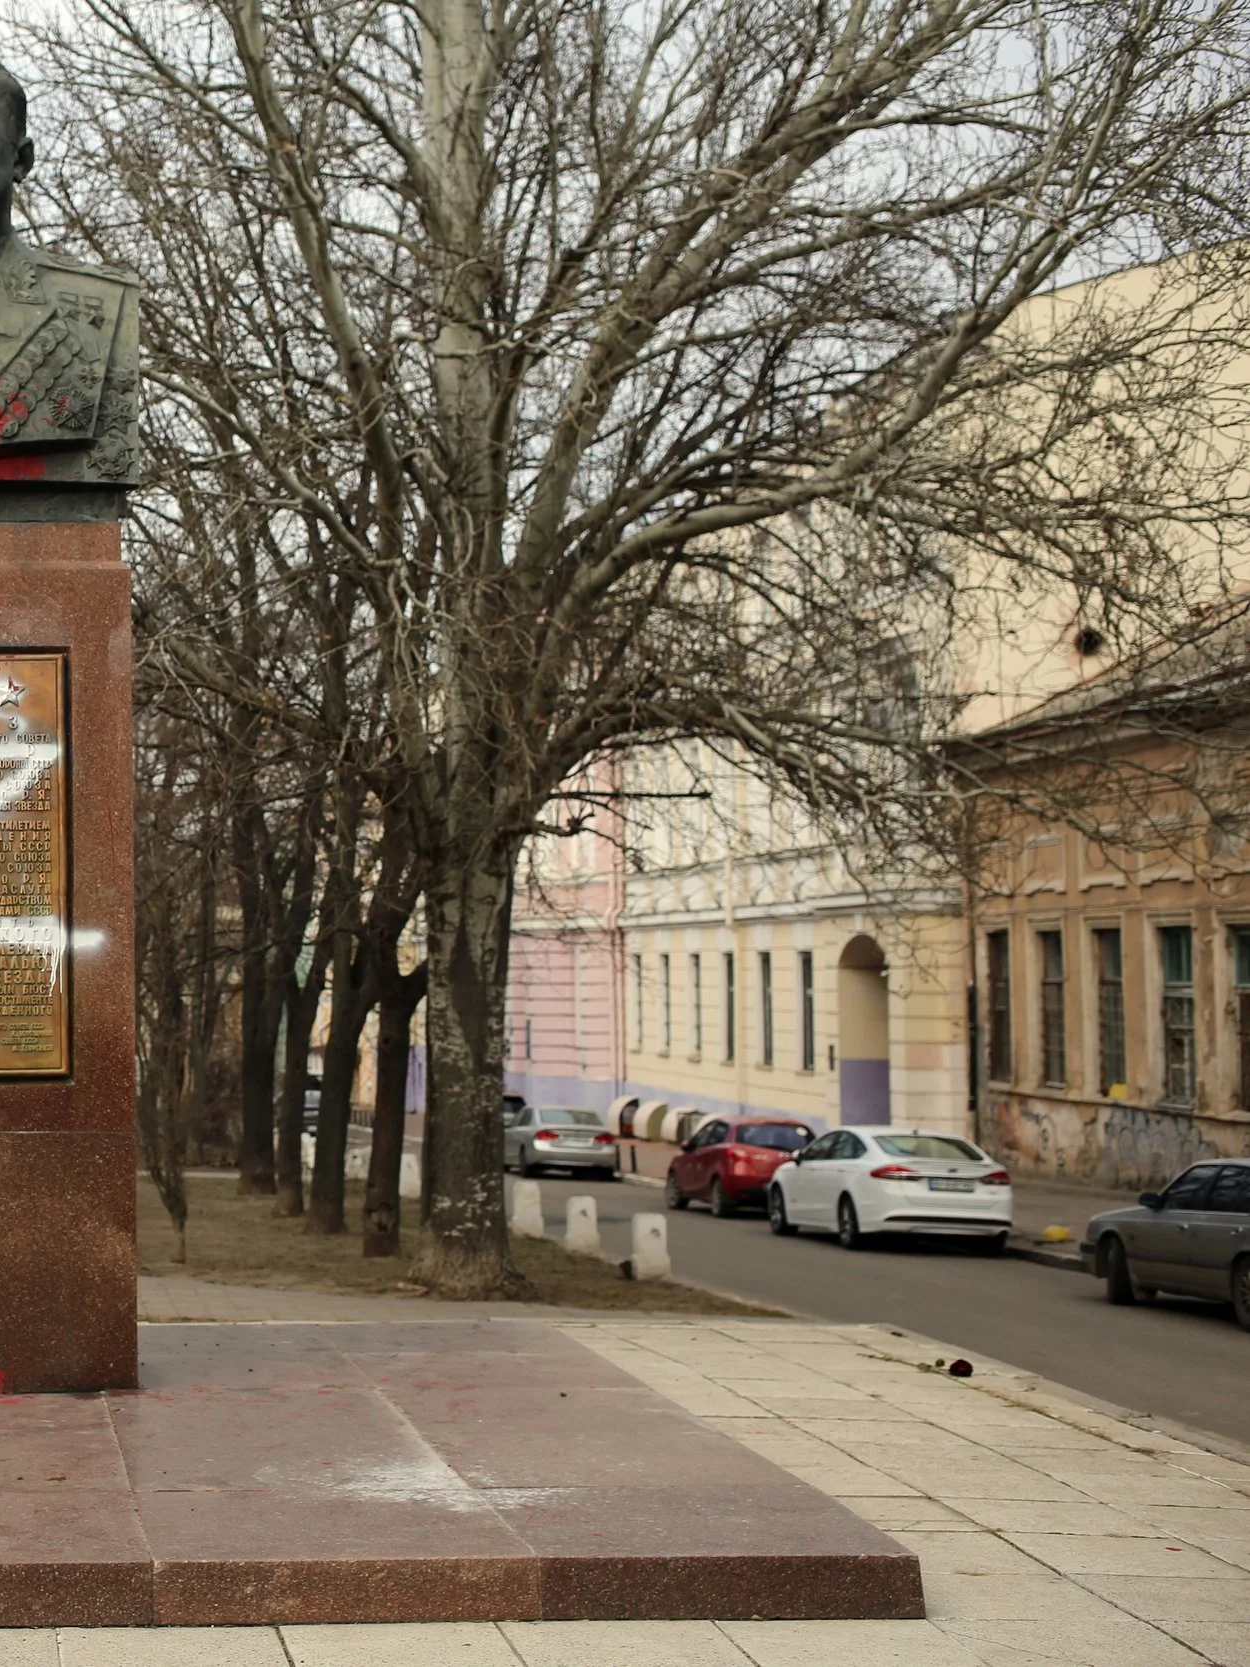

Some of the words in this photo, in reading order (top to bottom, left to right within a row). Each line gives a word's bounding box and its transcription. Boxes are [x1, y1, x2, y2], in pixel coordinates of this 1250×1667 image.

[17, 735, 51, 745] СОВЕТА
[22, 790, 32, 801] Р.
[38, 789, 50, 800] Я.
[15, 801, 51, 811] ЗВЕЗДА
[20, 841, 51, 852] СССР
[14, 852, 51, 862] СОЮЗА
[7, 862, 51, 873] СОЮЗА
[23, 874, 33, 884] Р.
[38, 873, 51, 883] Я.
[28, 905, 52, 916] СССР
[22, 984, 51, 995] БЮСТ
